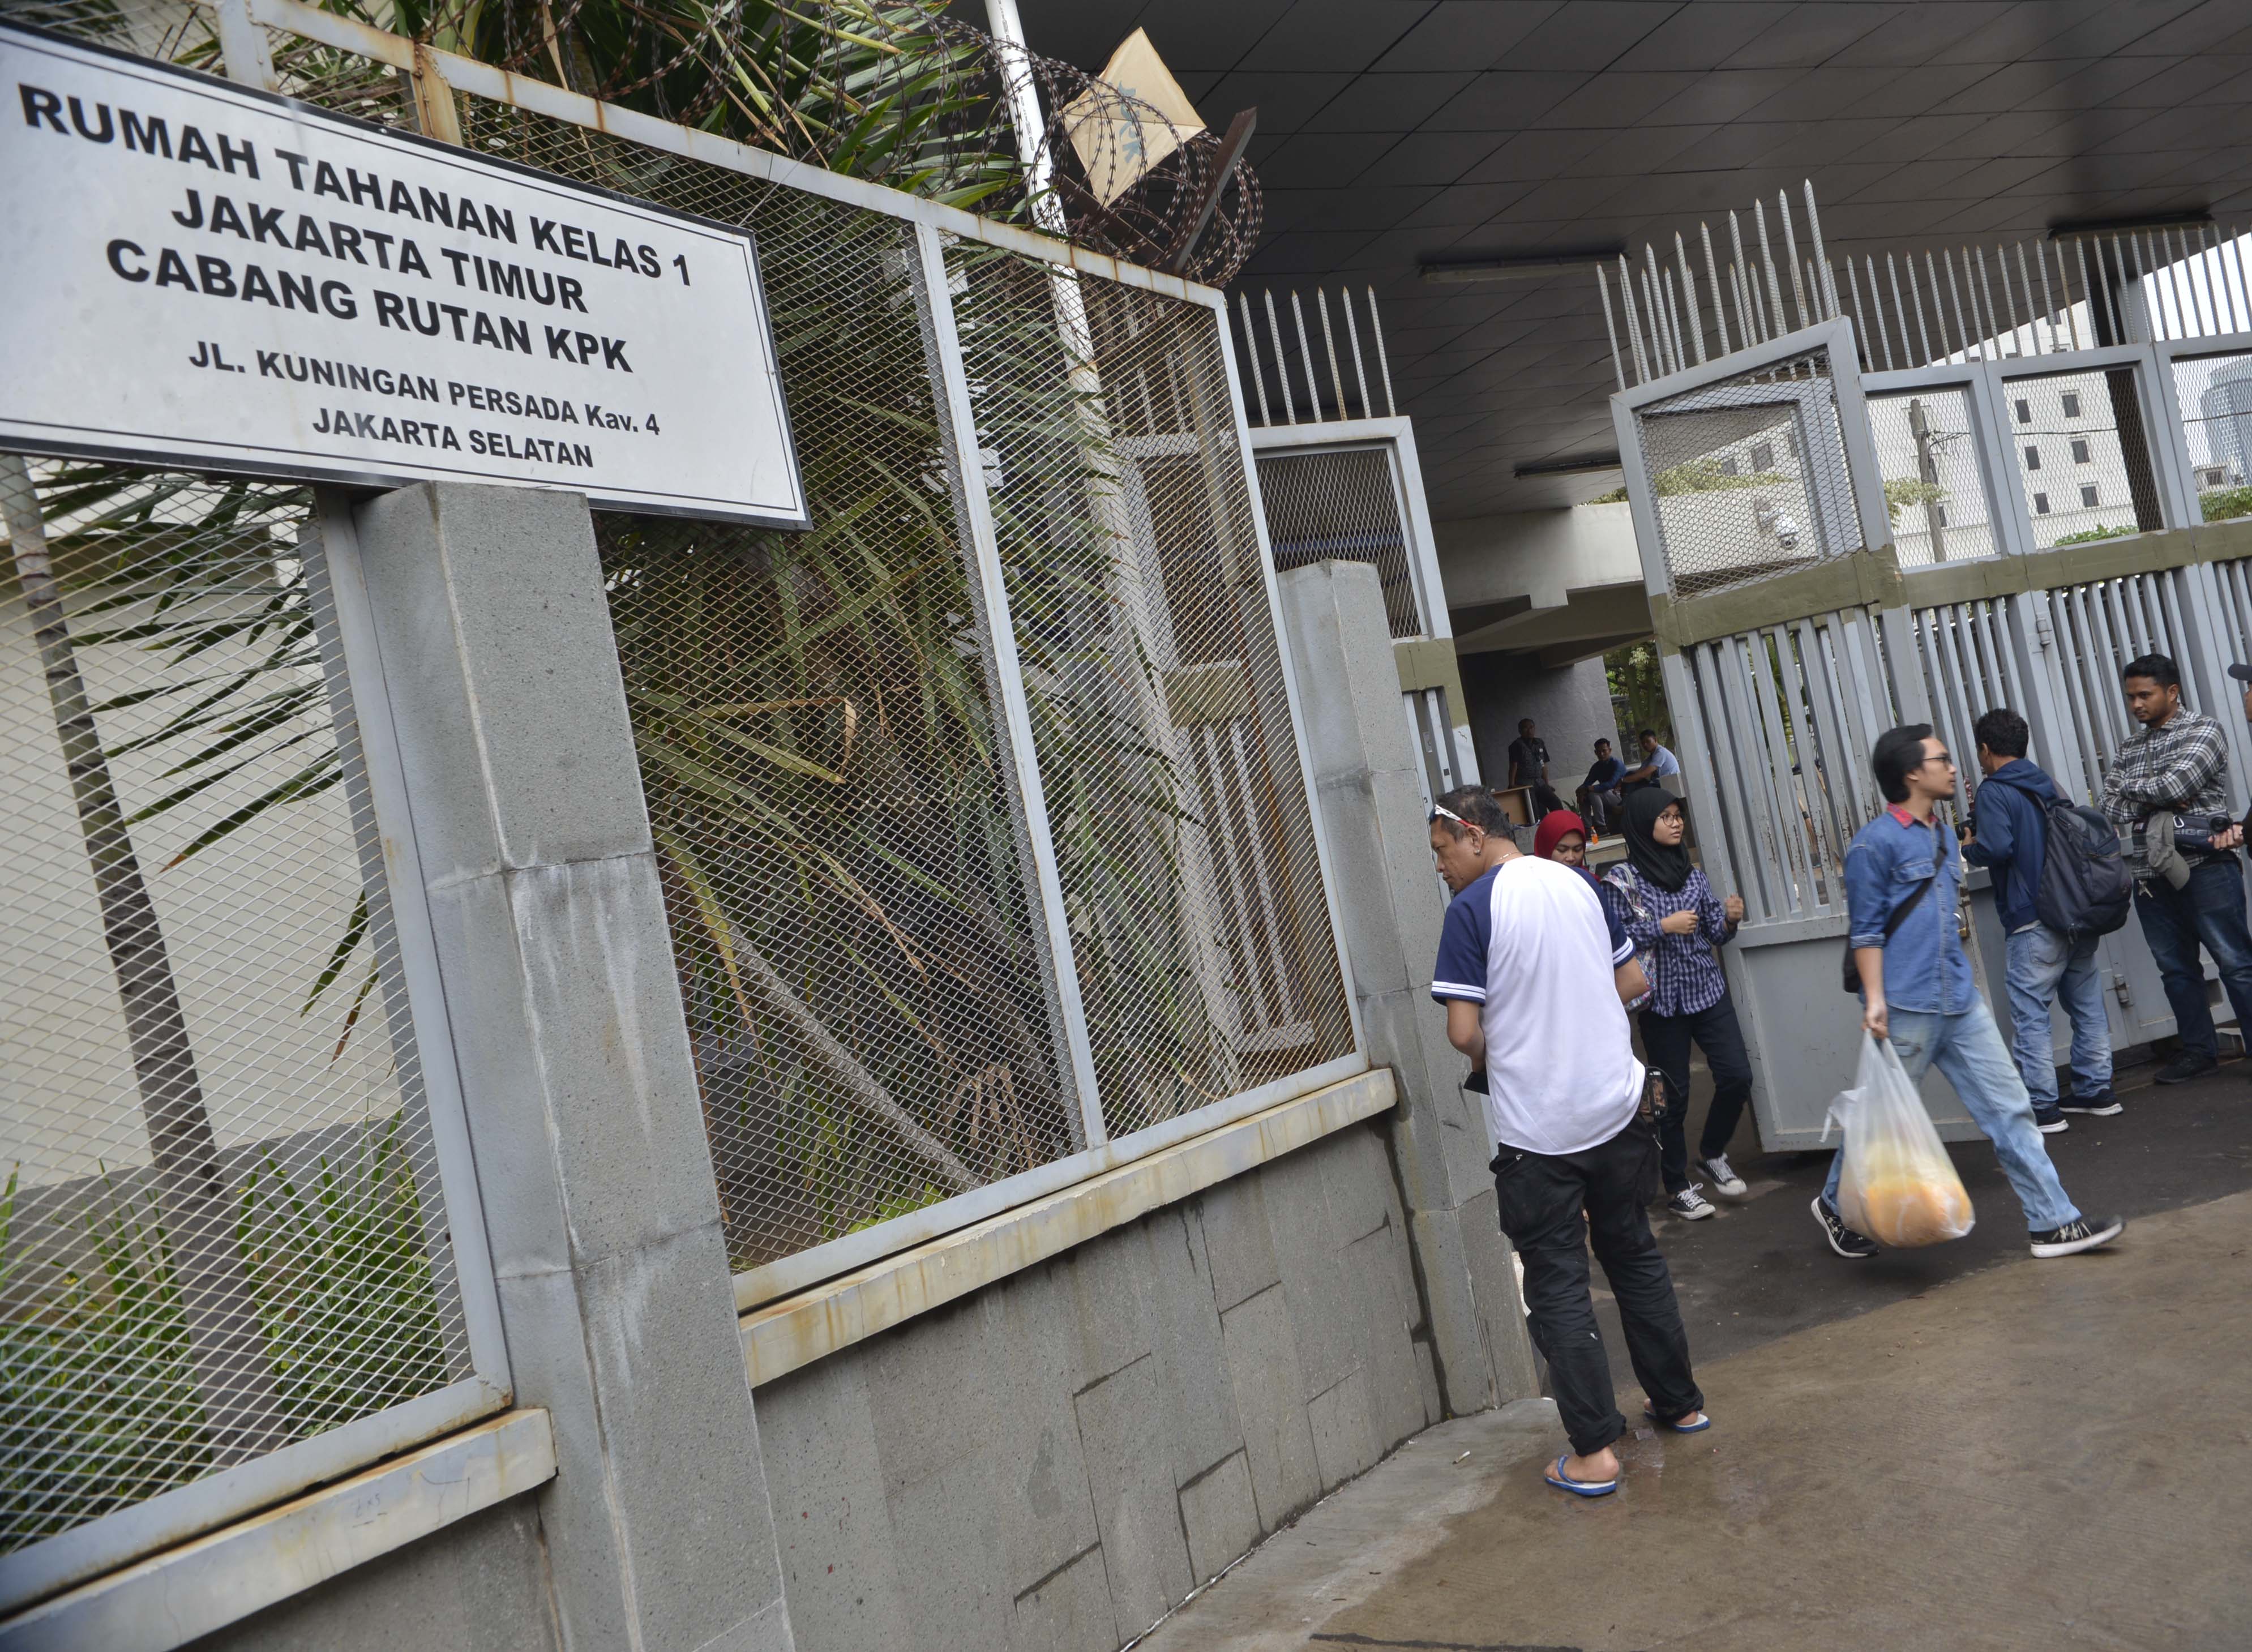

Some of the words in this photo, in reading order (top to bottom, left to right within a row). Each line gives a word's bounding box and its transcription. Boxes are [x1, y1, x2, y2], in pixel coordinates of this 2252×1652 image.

[18, 83, 260, 180] RUMAH
[275, 148, 517, 244] TAHANAN
[529, 216, 661, 278] KELAS
[672, 254, 691, 286] 1
[106, 239, 358, 320] CABANG
[373, 289, 532, 354] RUTAN
[544, 325, 633, 373] KPK
[172, 189, 432, 279] JAKARTA
[440, 247, 588, 314] TIMUR
[189, 340, 246, 374] JL.
[256, 350, 439, 403] KUNINGAN
[448, 382, 579, 424] PERSADA
[584, 404, 639, 433] Kav.
[645, 413, 660, 435] 4
[312, 408, 461, 451] JAKARTA
[469, 430, 593, 468] SELATAN
